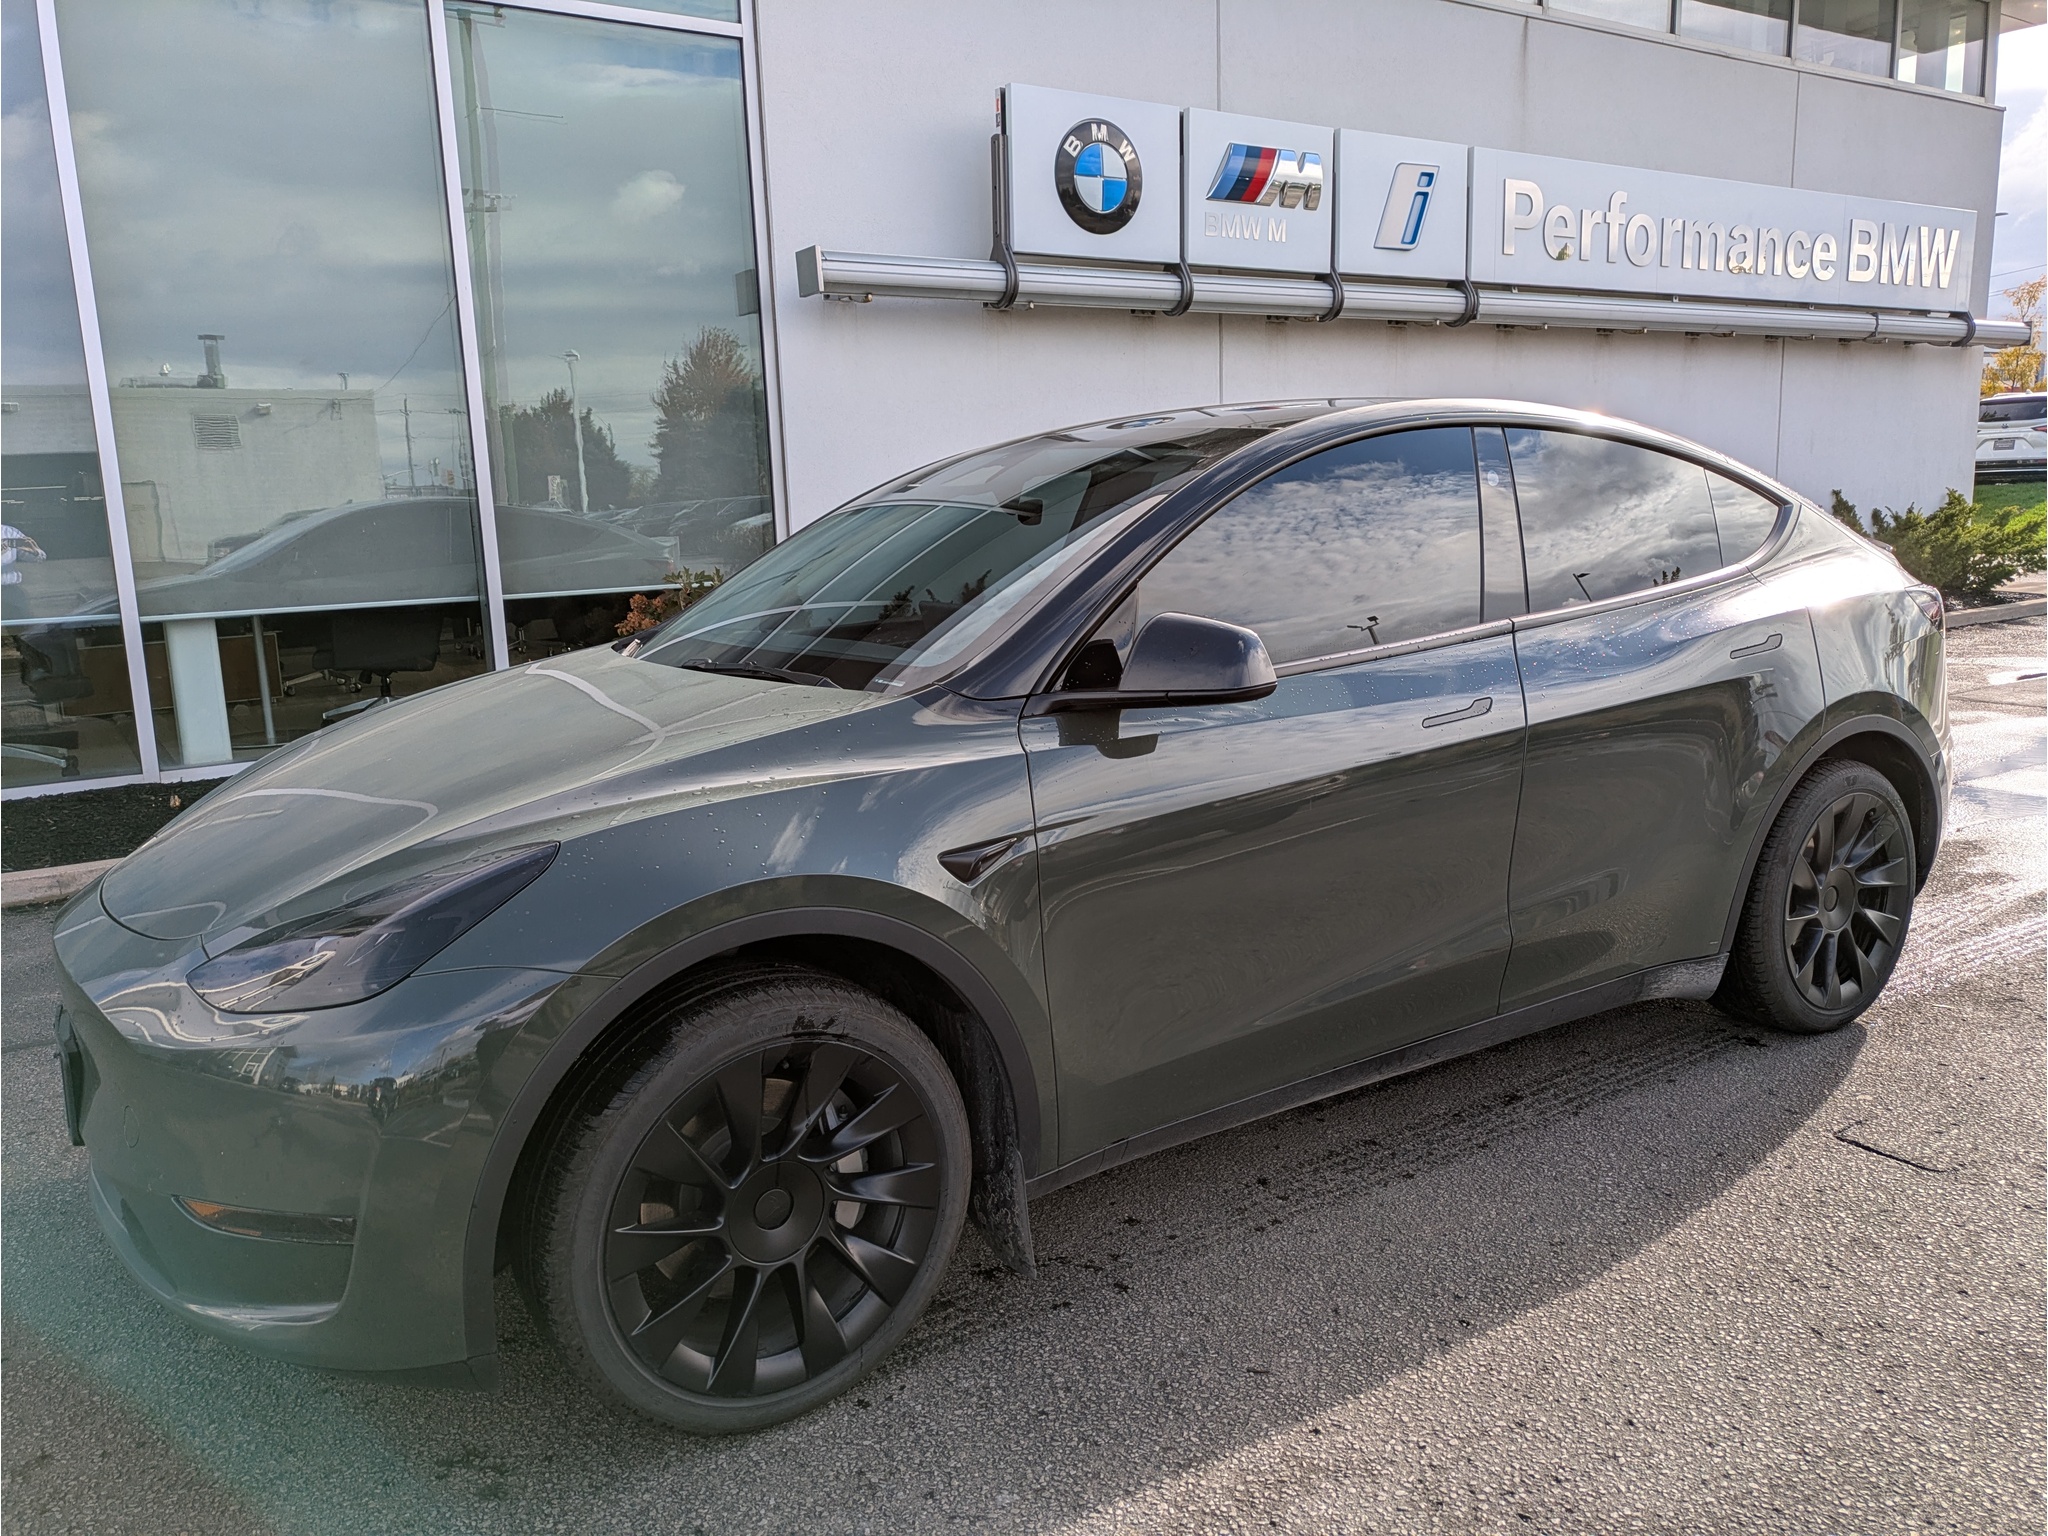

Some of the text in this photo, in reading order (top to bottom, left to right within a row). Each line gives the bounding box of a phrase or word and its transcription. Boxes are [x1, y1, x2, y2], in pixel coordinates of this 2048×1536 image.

[1063, 123, 1135, 162] BMW
[1205, 211, 1287, 243] BMW M
[1400, 171, 1435, 245] i
[1502, 178, 1960, 289] Performance BMW
